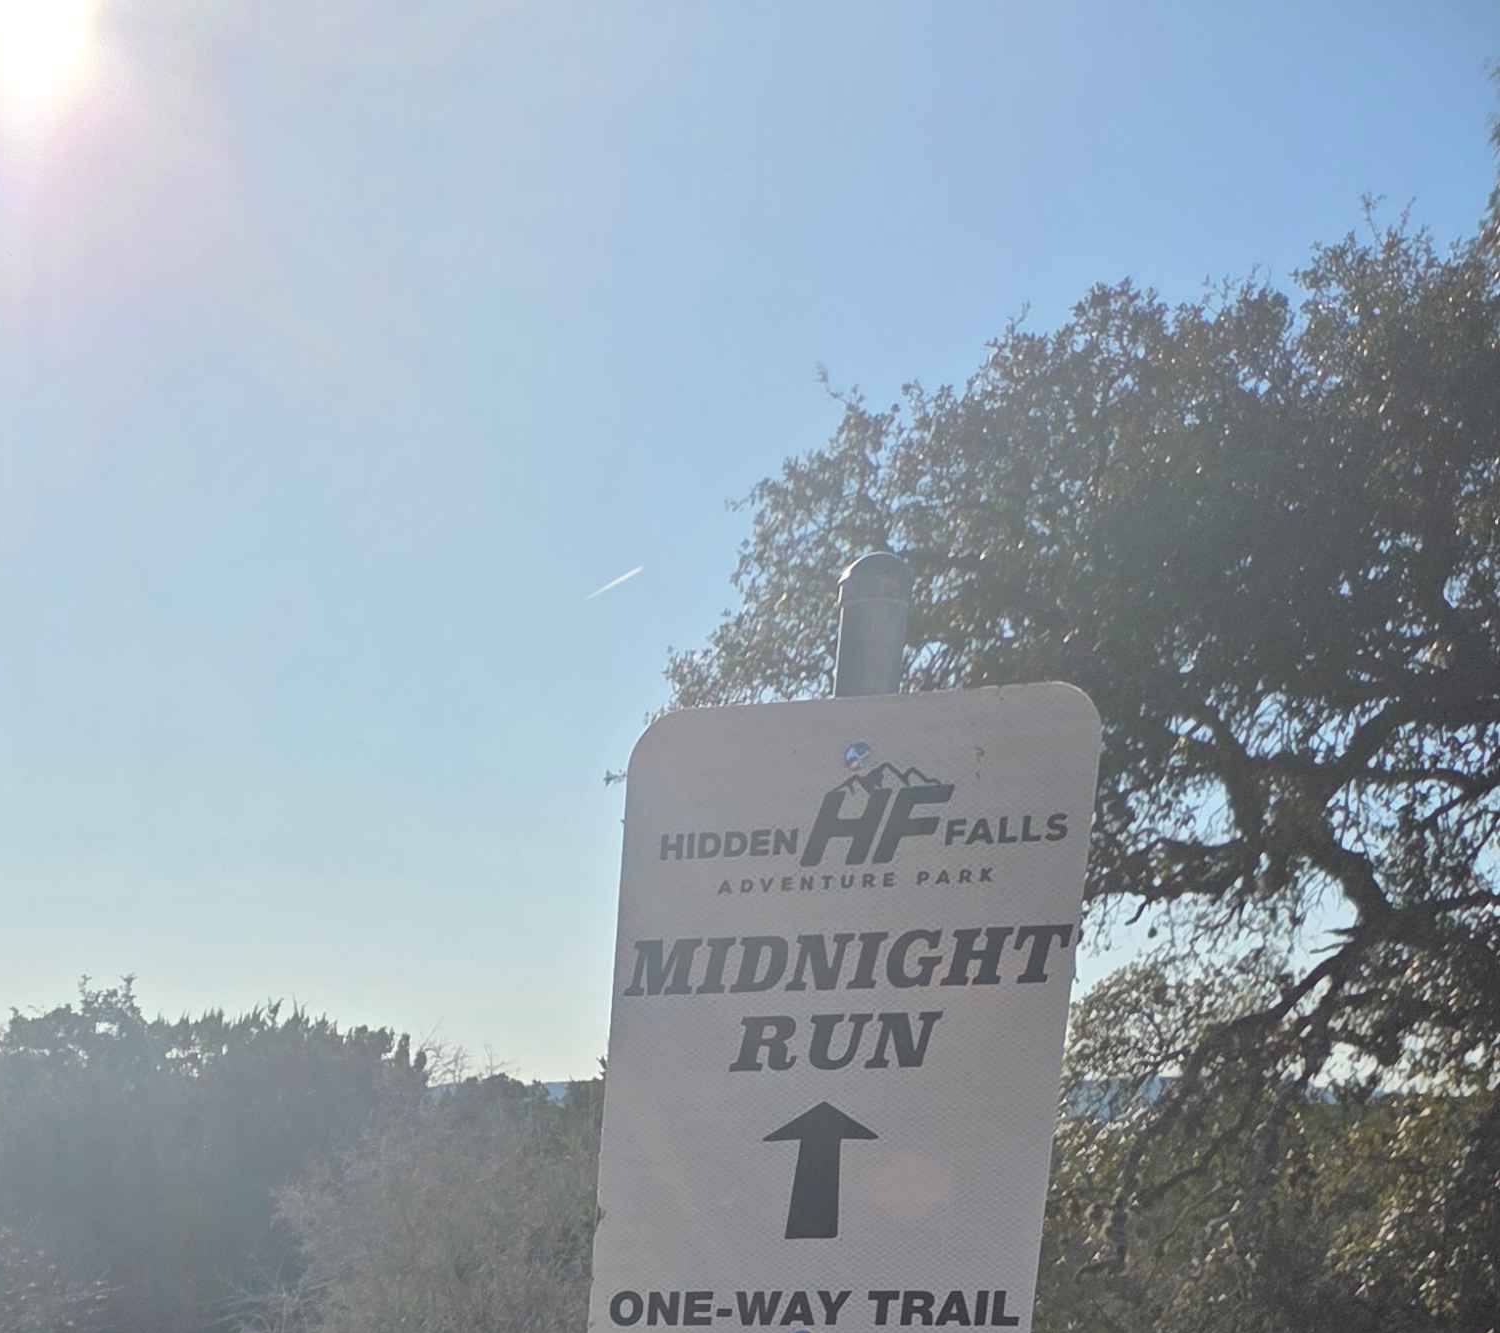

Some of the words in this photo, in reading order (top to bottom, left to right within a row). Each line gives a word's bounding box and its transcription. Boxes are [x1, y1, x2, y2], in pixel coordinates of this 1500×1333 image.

[659, 828, 799, 860] HIDDEN
[944, 813, 1068, 846] FALLS
[717, 871, 896, 895] ADVENTURE
[916, 867, 995, 886] PARK
[623, 925, 1073, 996] MIDNIGHT
[729, 1011, 943, 1072] RUN
[609, 1291, 853, 1326] ONE-WAY
[868, 1291, 1020, 1326] TRAIL
